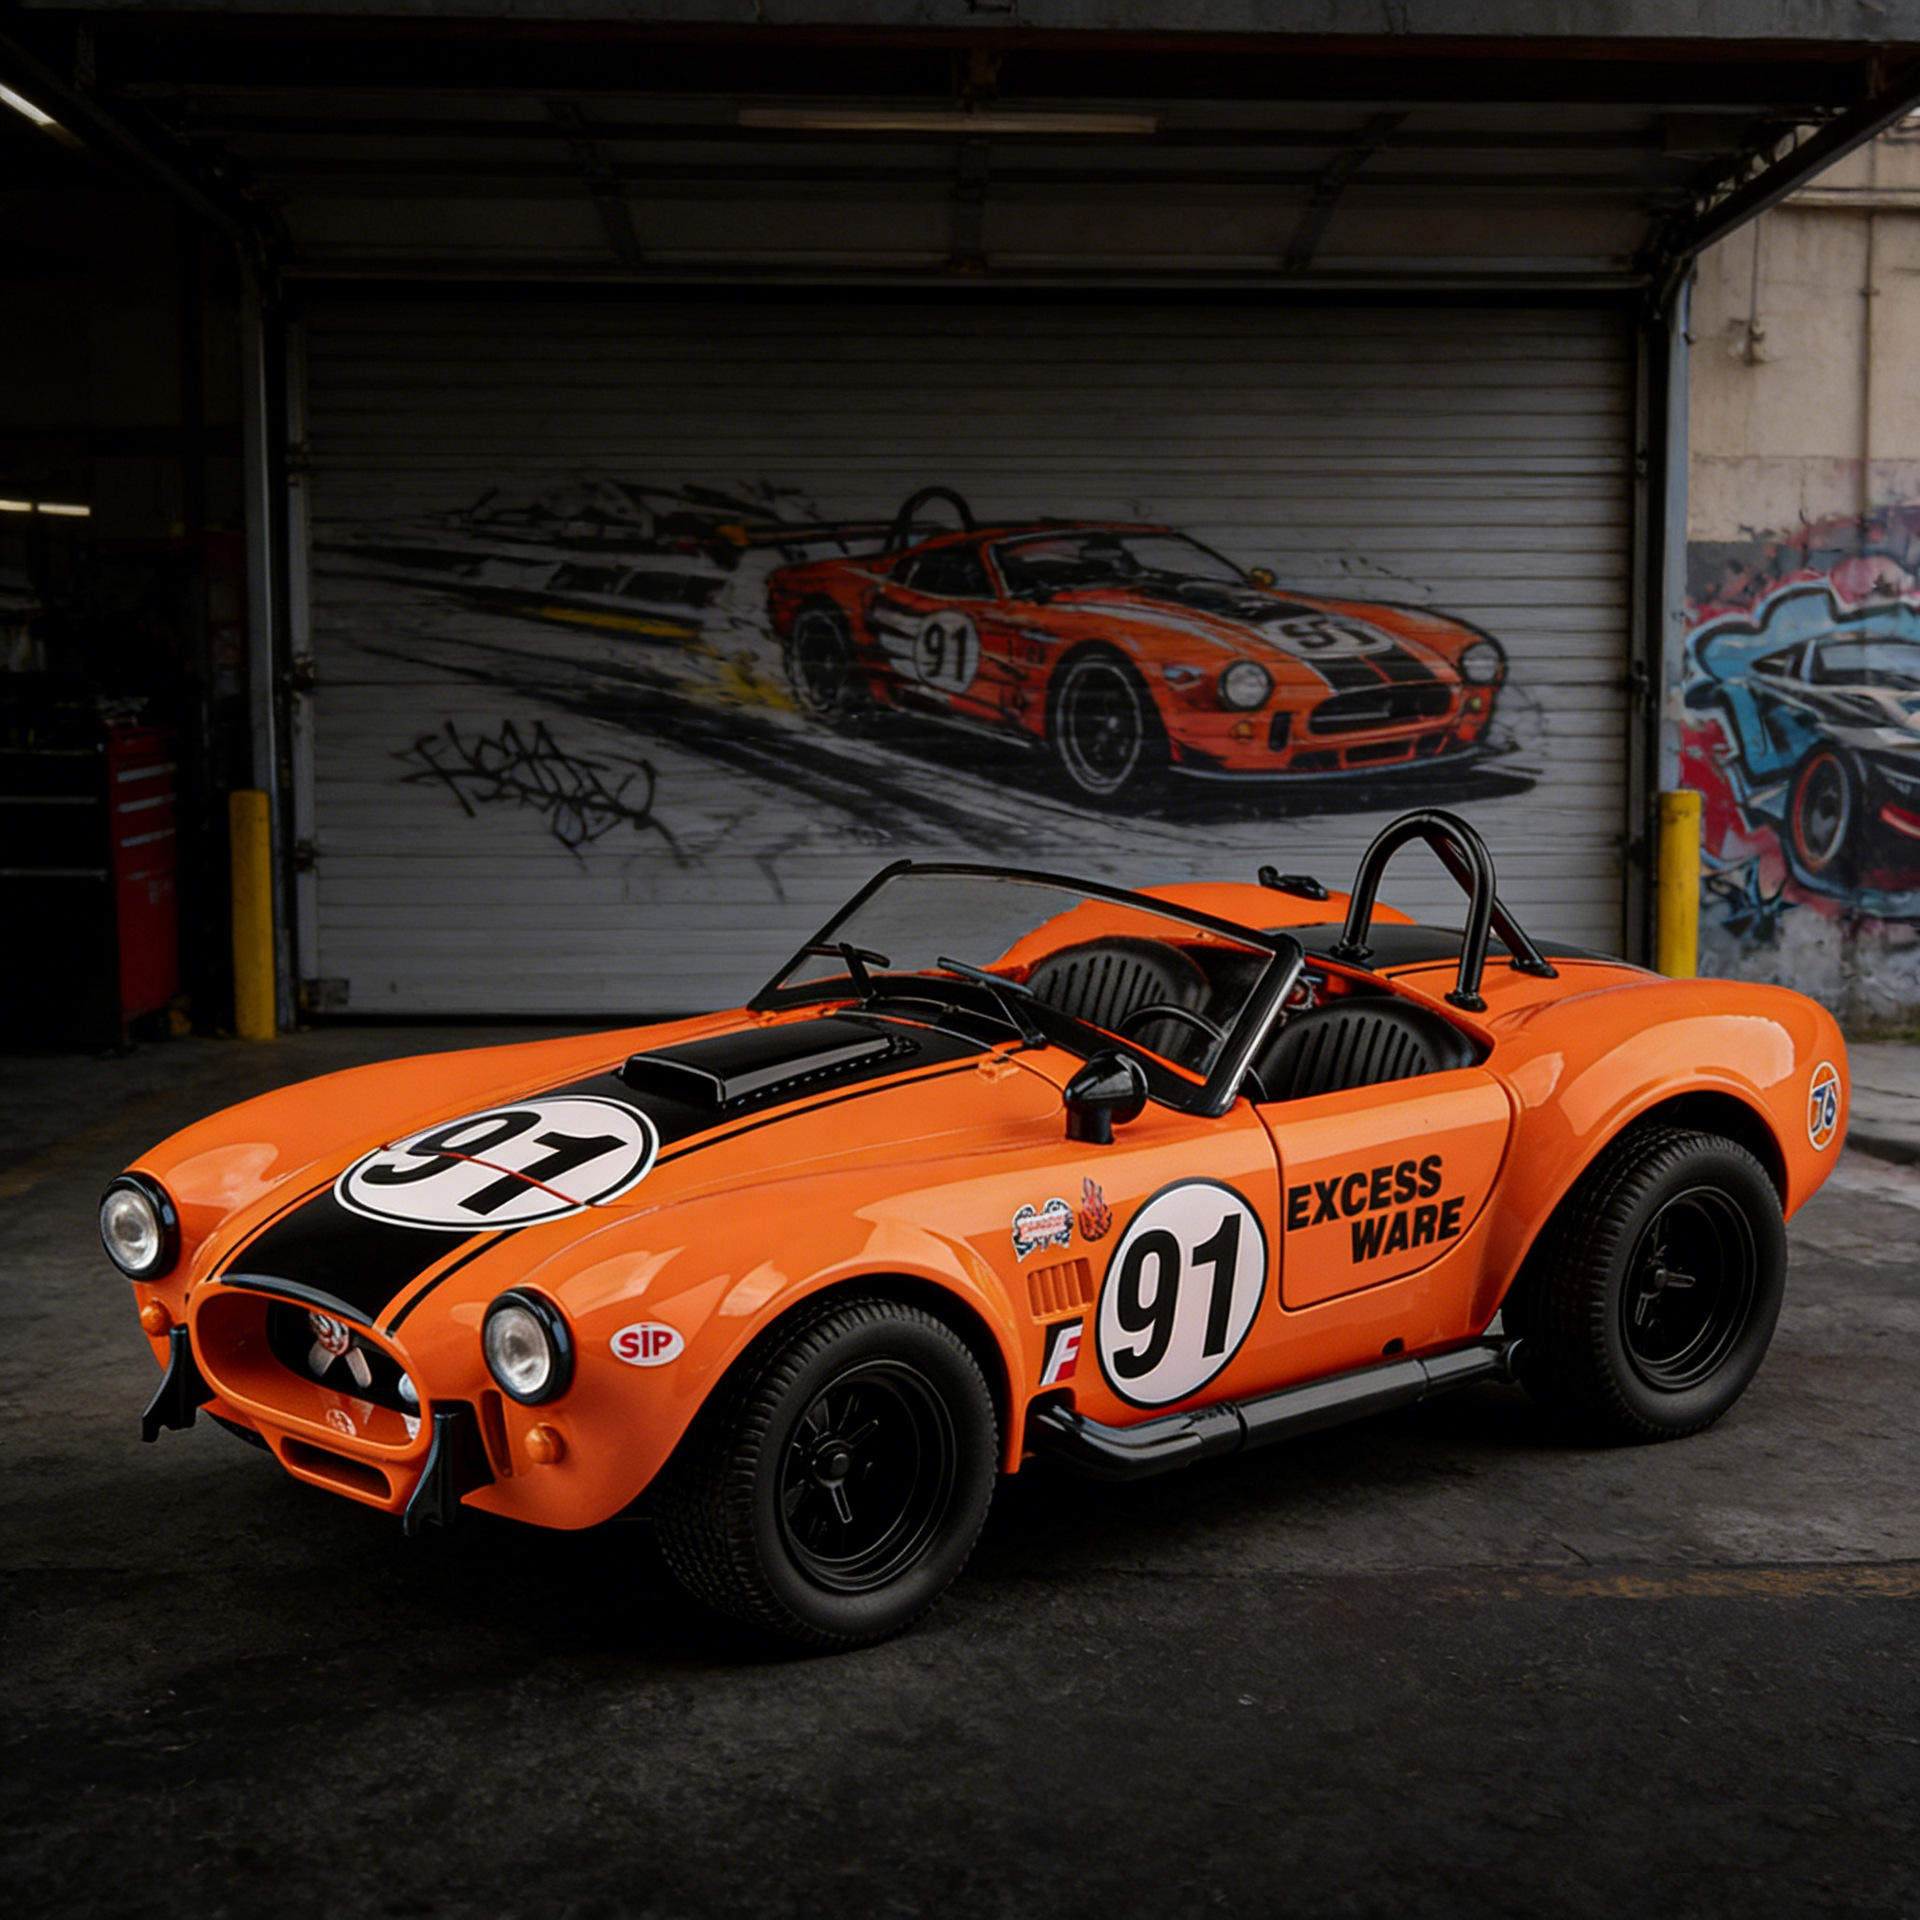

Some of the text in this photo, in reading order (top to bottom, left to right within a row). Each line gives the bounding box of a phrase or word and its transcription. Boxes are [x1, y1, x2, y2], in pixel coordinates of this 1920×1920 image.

[922, 623, 968, 682] 91
[360, 1110, 629, 1217] 91
[1286, 1154, 1443, 1232] EXCESS
[1352, 1195, 1466, 1265] WARE
[1112, 1212, 1242, 1380] 91
